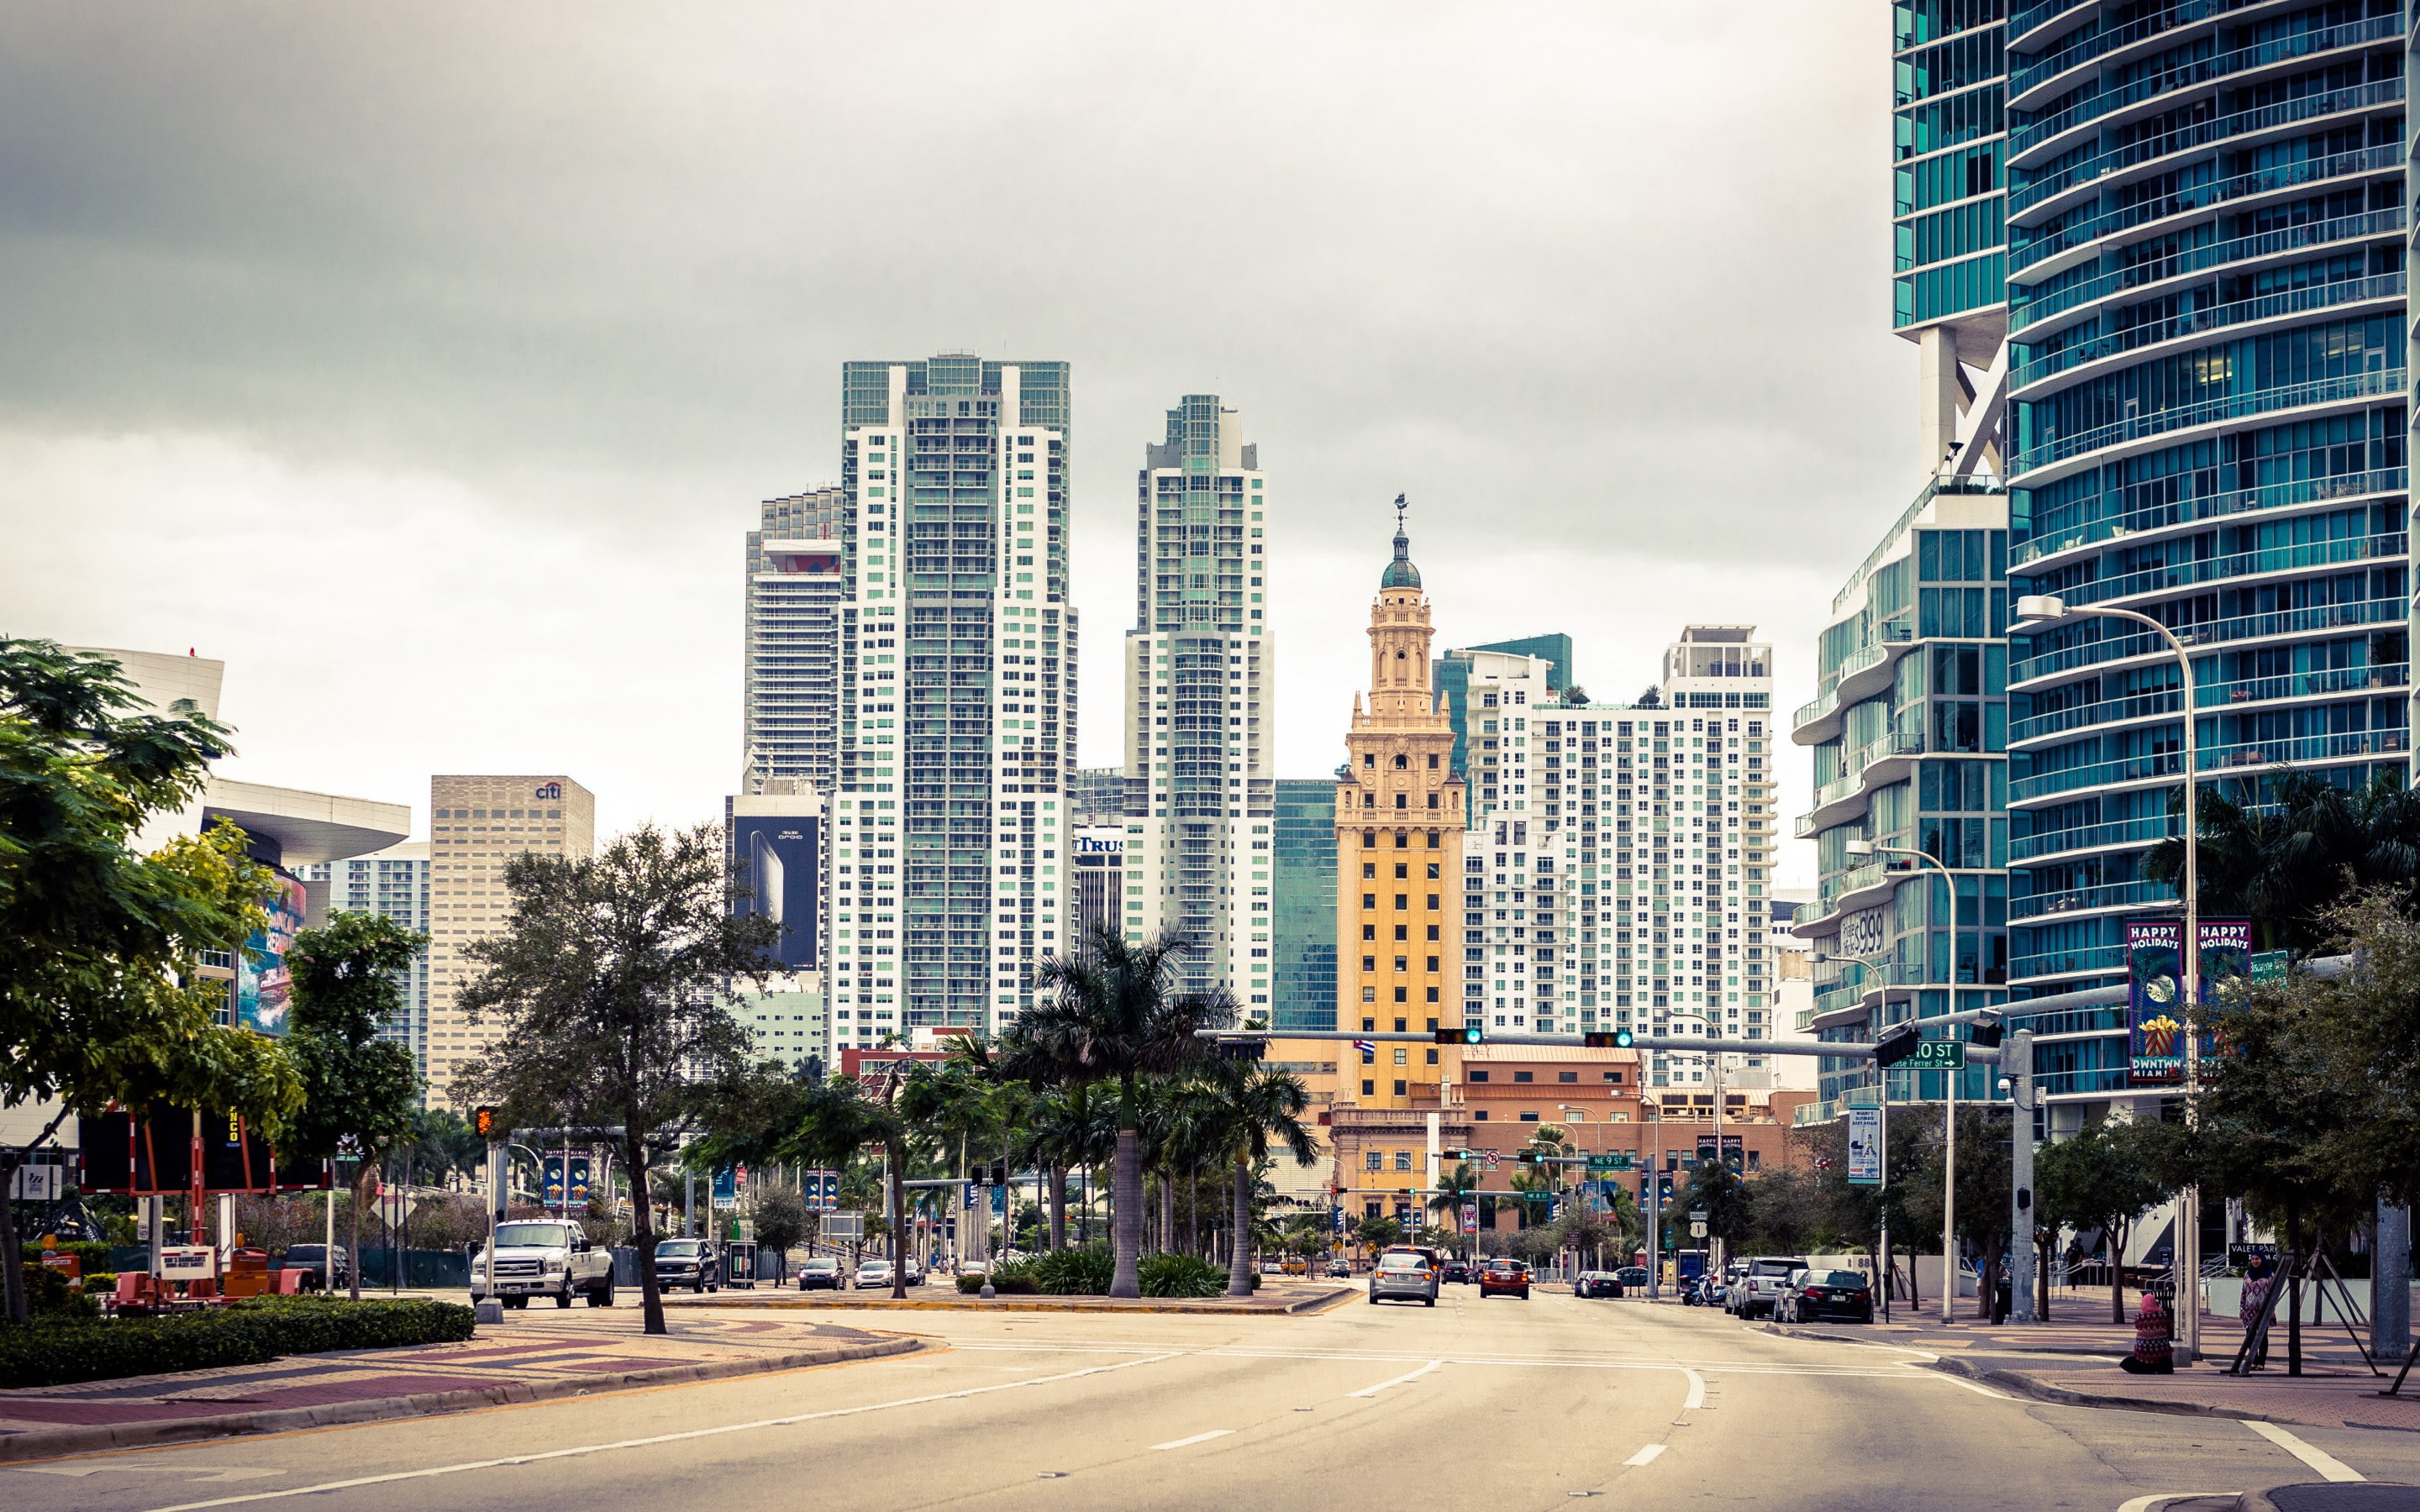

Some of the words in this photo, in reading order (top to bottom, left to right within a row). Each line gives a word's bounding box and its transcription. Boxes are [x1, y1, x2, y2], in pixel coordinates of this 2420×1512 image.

[535, 783, 560, 800] citi
[2131, 927, 2176, 937] HAPPY
[2201, 926, 2246, 937] HAPPY
[2130, 938, 2179, 950] HOLIDAYS
[2200, 938, 2249, 950] HOLIDAYS
[1936, 1044, 1953, 1057] ST
[1909, 1058, 1933, 1067] Ferrer
[1934, 1058, 1944, 1067] St
[2132, 1058, 2181, 1069] DWNTWN
[1606, 1157, 1612, 1165] 9
[1697, 1225, 1700, 1235] 1
[1858, 1258, 1870, 1268] 88
